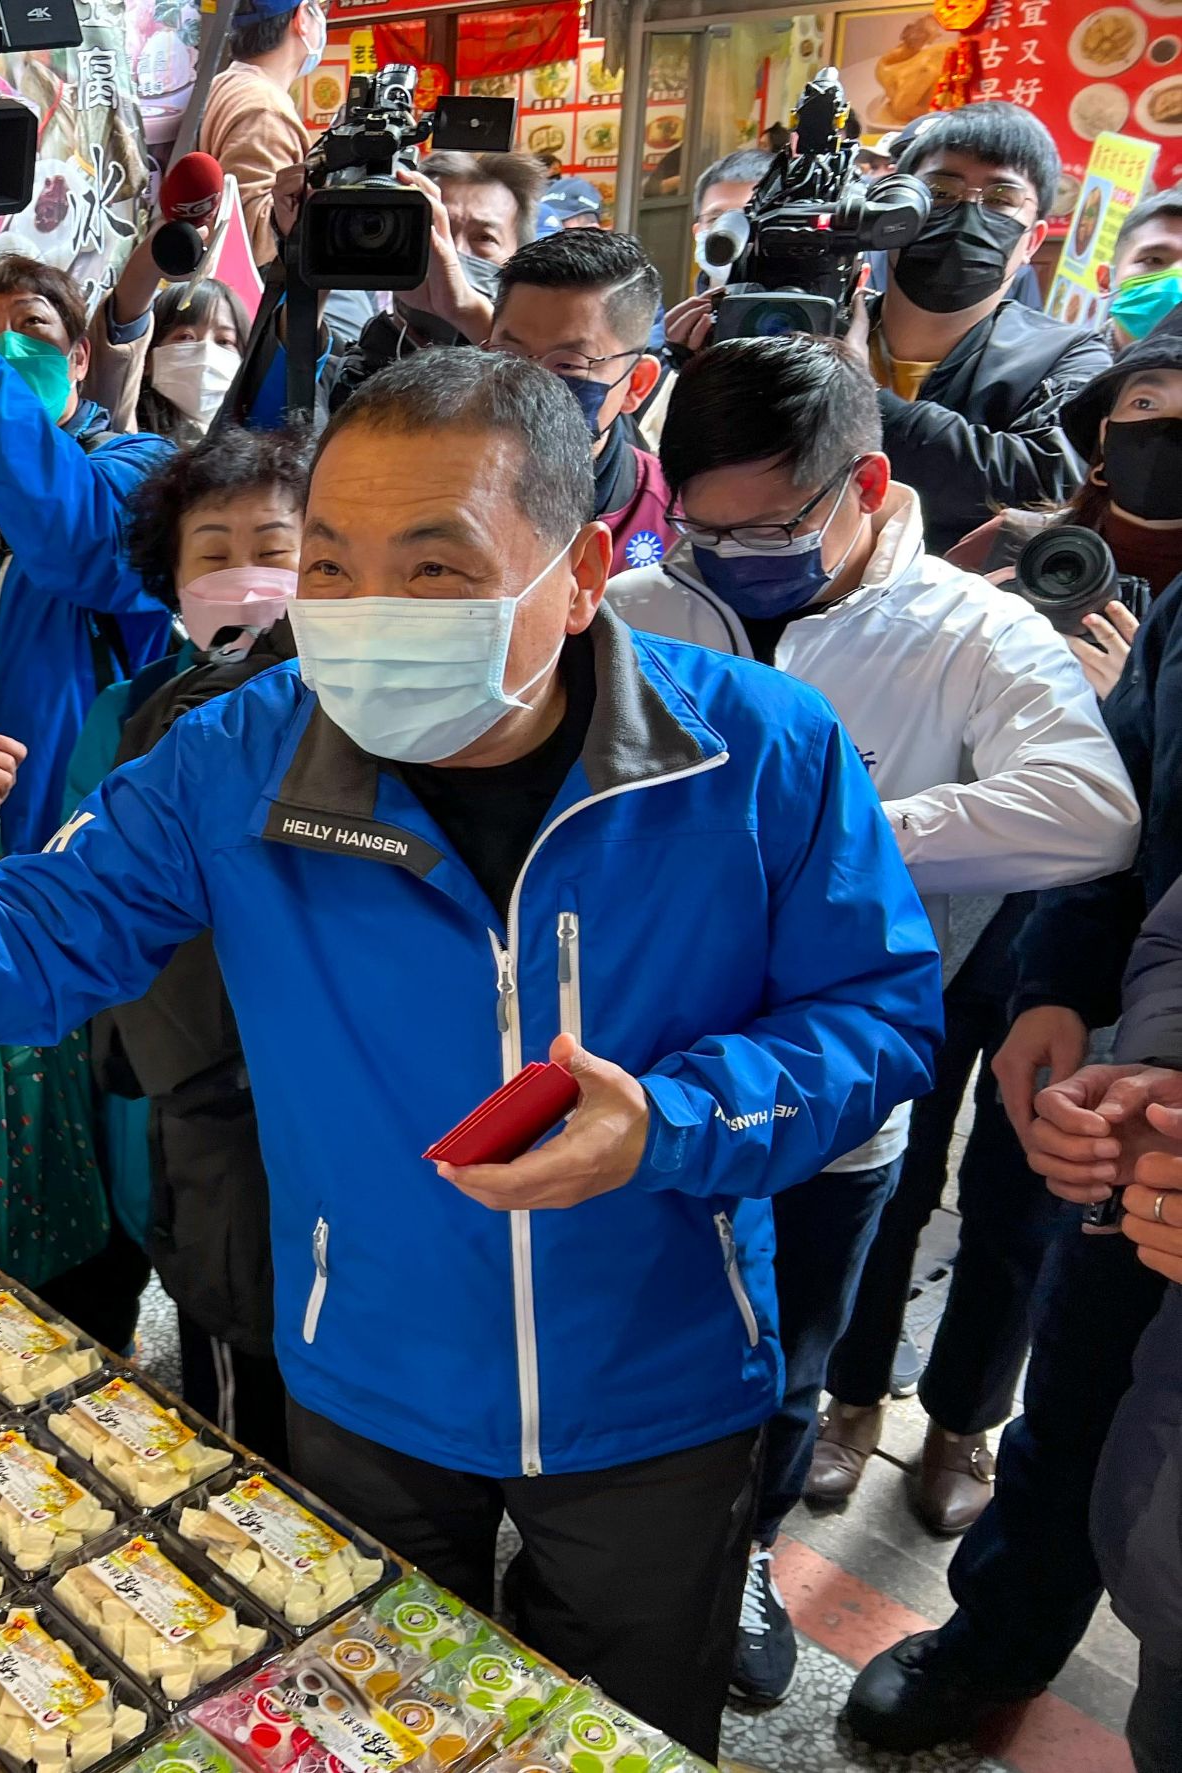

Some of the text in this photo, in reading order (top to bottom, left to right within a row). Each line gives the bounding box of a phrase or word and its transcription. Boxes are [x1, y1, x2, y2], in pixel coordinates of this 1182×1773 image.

[26, 7, 52, 18] 4K
[282, 818, 408, 856] HELLY HANSEN
